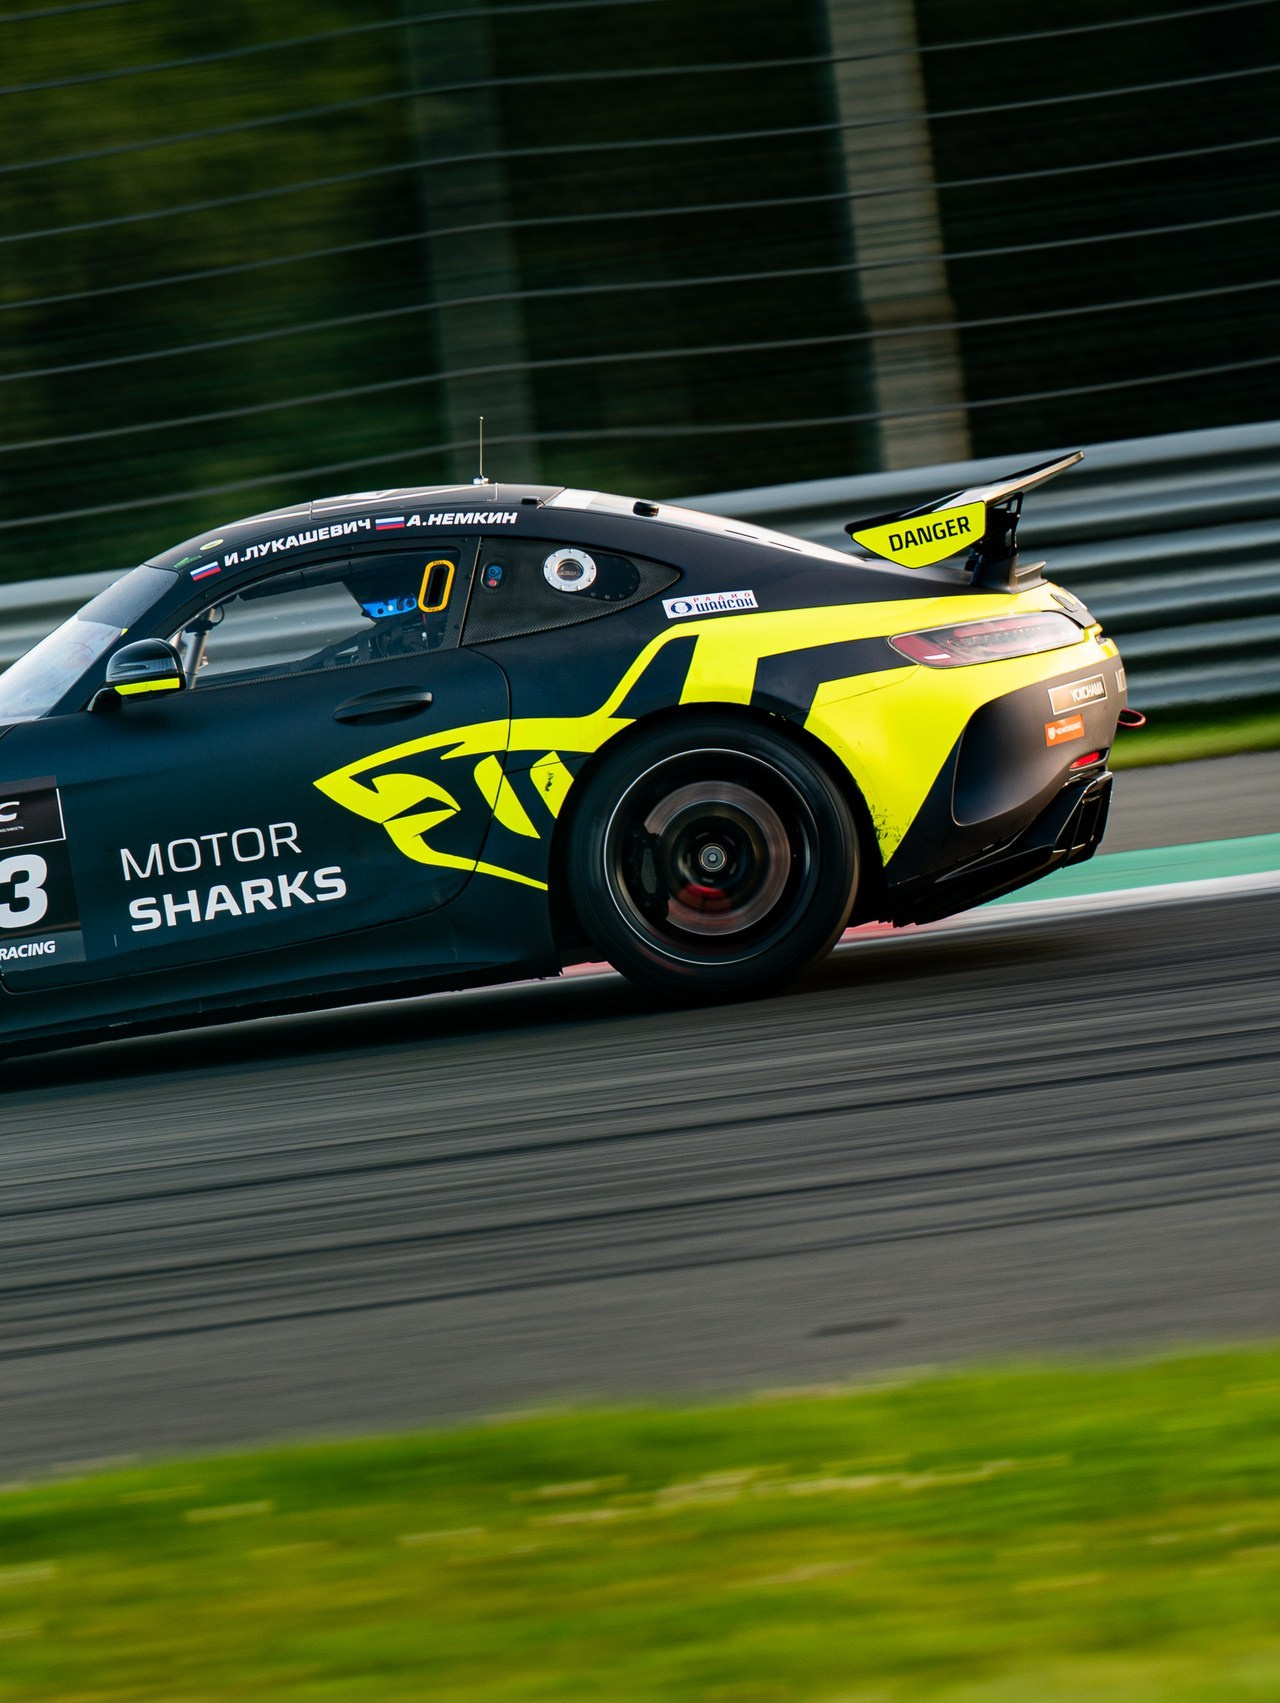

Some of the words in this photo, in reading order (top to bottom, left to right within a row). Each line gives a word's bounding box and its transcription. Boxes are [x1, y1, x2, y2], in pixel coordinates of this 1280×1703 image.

[224, 518, 371, 567] И.ЛУКАШЕВИЧ
[406, 512, 518, 527] А.НЕМКИН
[888, 516, 971, 552] DANGER
[693, 592, 750, 603] РАДИО
[696, 598, 754, 612] ШАНСОН
[1070, 681, 1105, 702] YOKOHAMA
[120, 821, 302, 881] MOTOR
[129, 866, 347, 932] SHARKS
